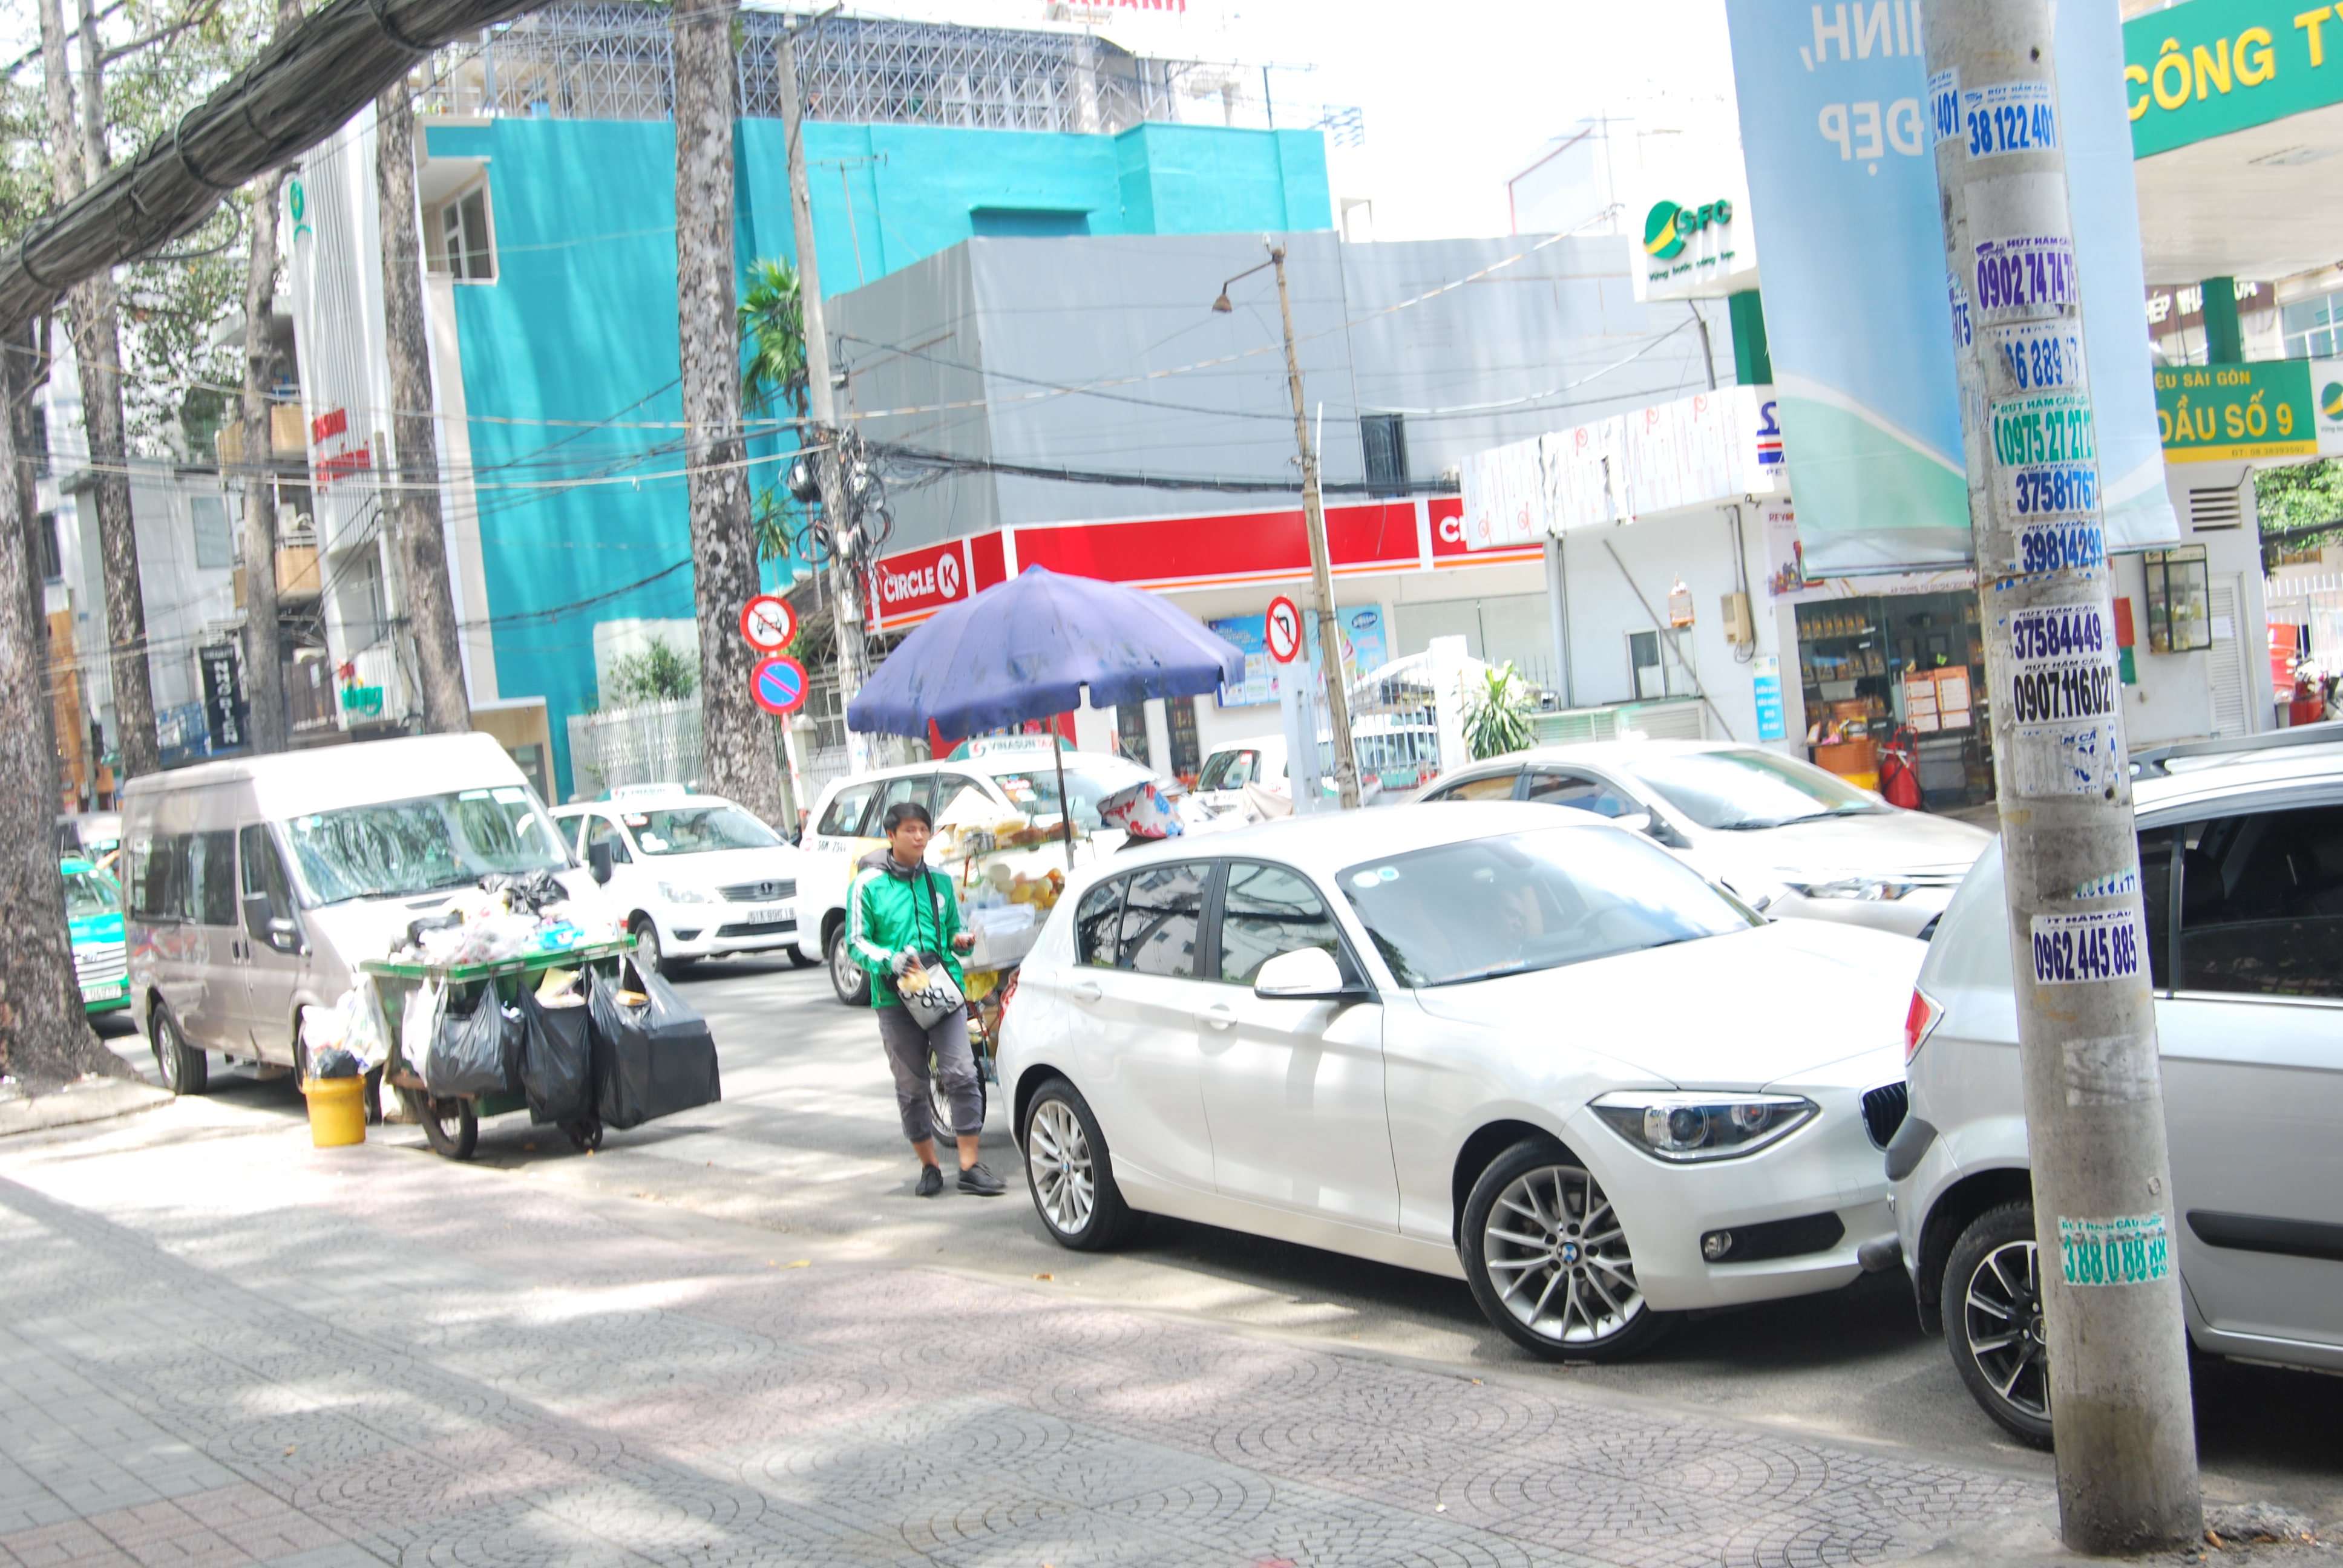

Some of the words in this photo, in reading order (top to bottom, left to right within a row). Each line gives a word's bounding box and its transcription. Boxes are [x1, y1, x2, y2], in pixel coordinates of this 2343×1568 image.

[2123, 27, 2275, 122] CÔNG
[1967, 103, 2056, 157] 38.122.401
[1679, 198, 1731, 235] SFC
[2183, 371, 2210, 387] SÀI
[2217, 368, 2252, 386] GÒN
[2225, 388, 2268, 439] SỐ
[2276, 403, 2293, 436] 9
[2016, 470, 2095, 514] 37581767
[2022, 528, 2102, 573] 39814299
[883, 565, 936, 603] CIRCLE
[2013, 612, 2102, 661] 37584449
[2013, 666, 2114, 724] 0907.116.027
[989, 737, 1036, 751] VINASUN
[2034, 924, 2137, 982] 0962.445.885
